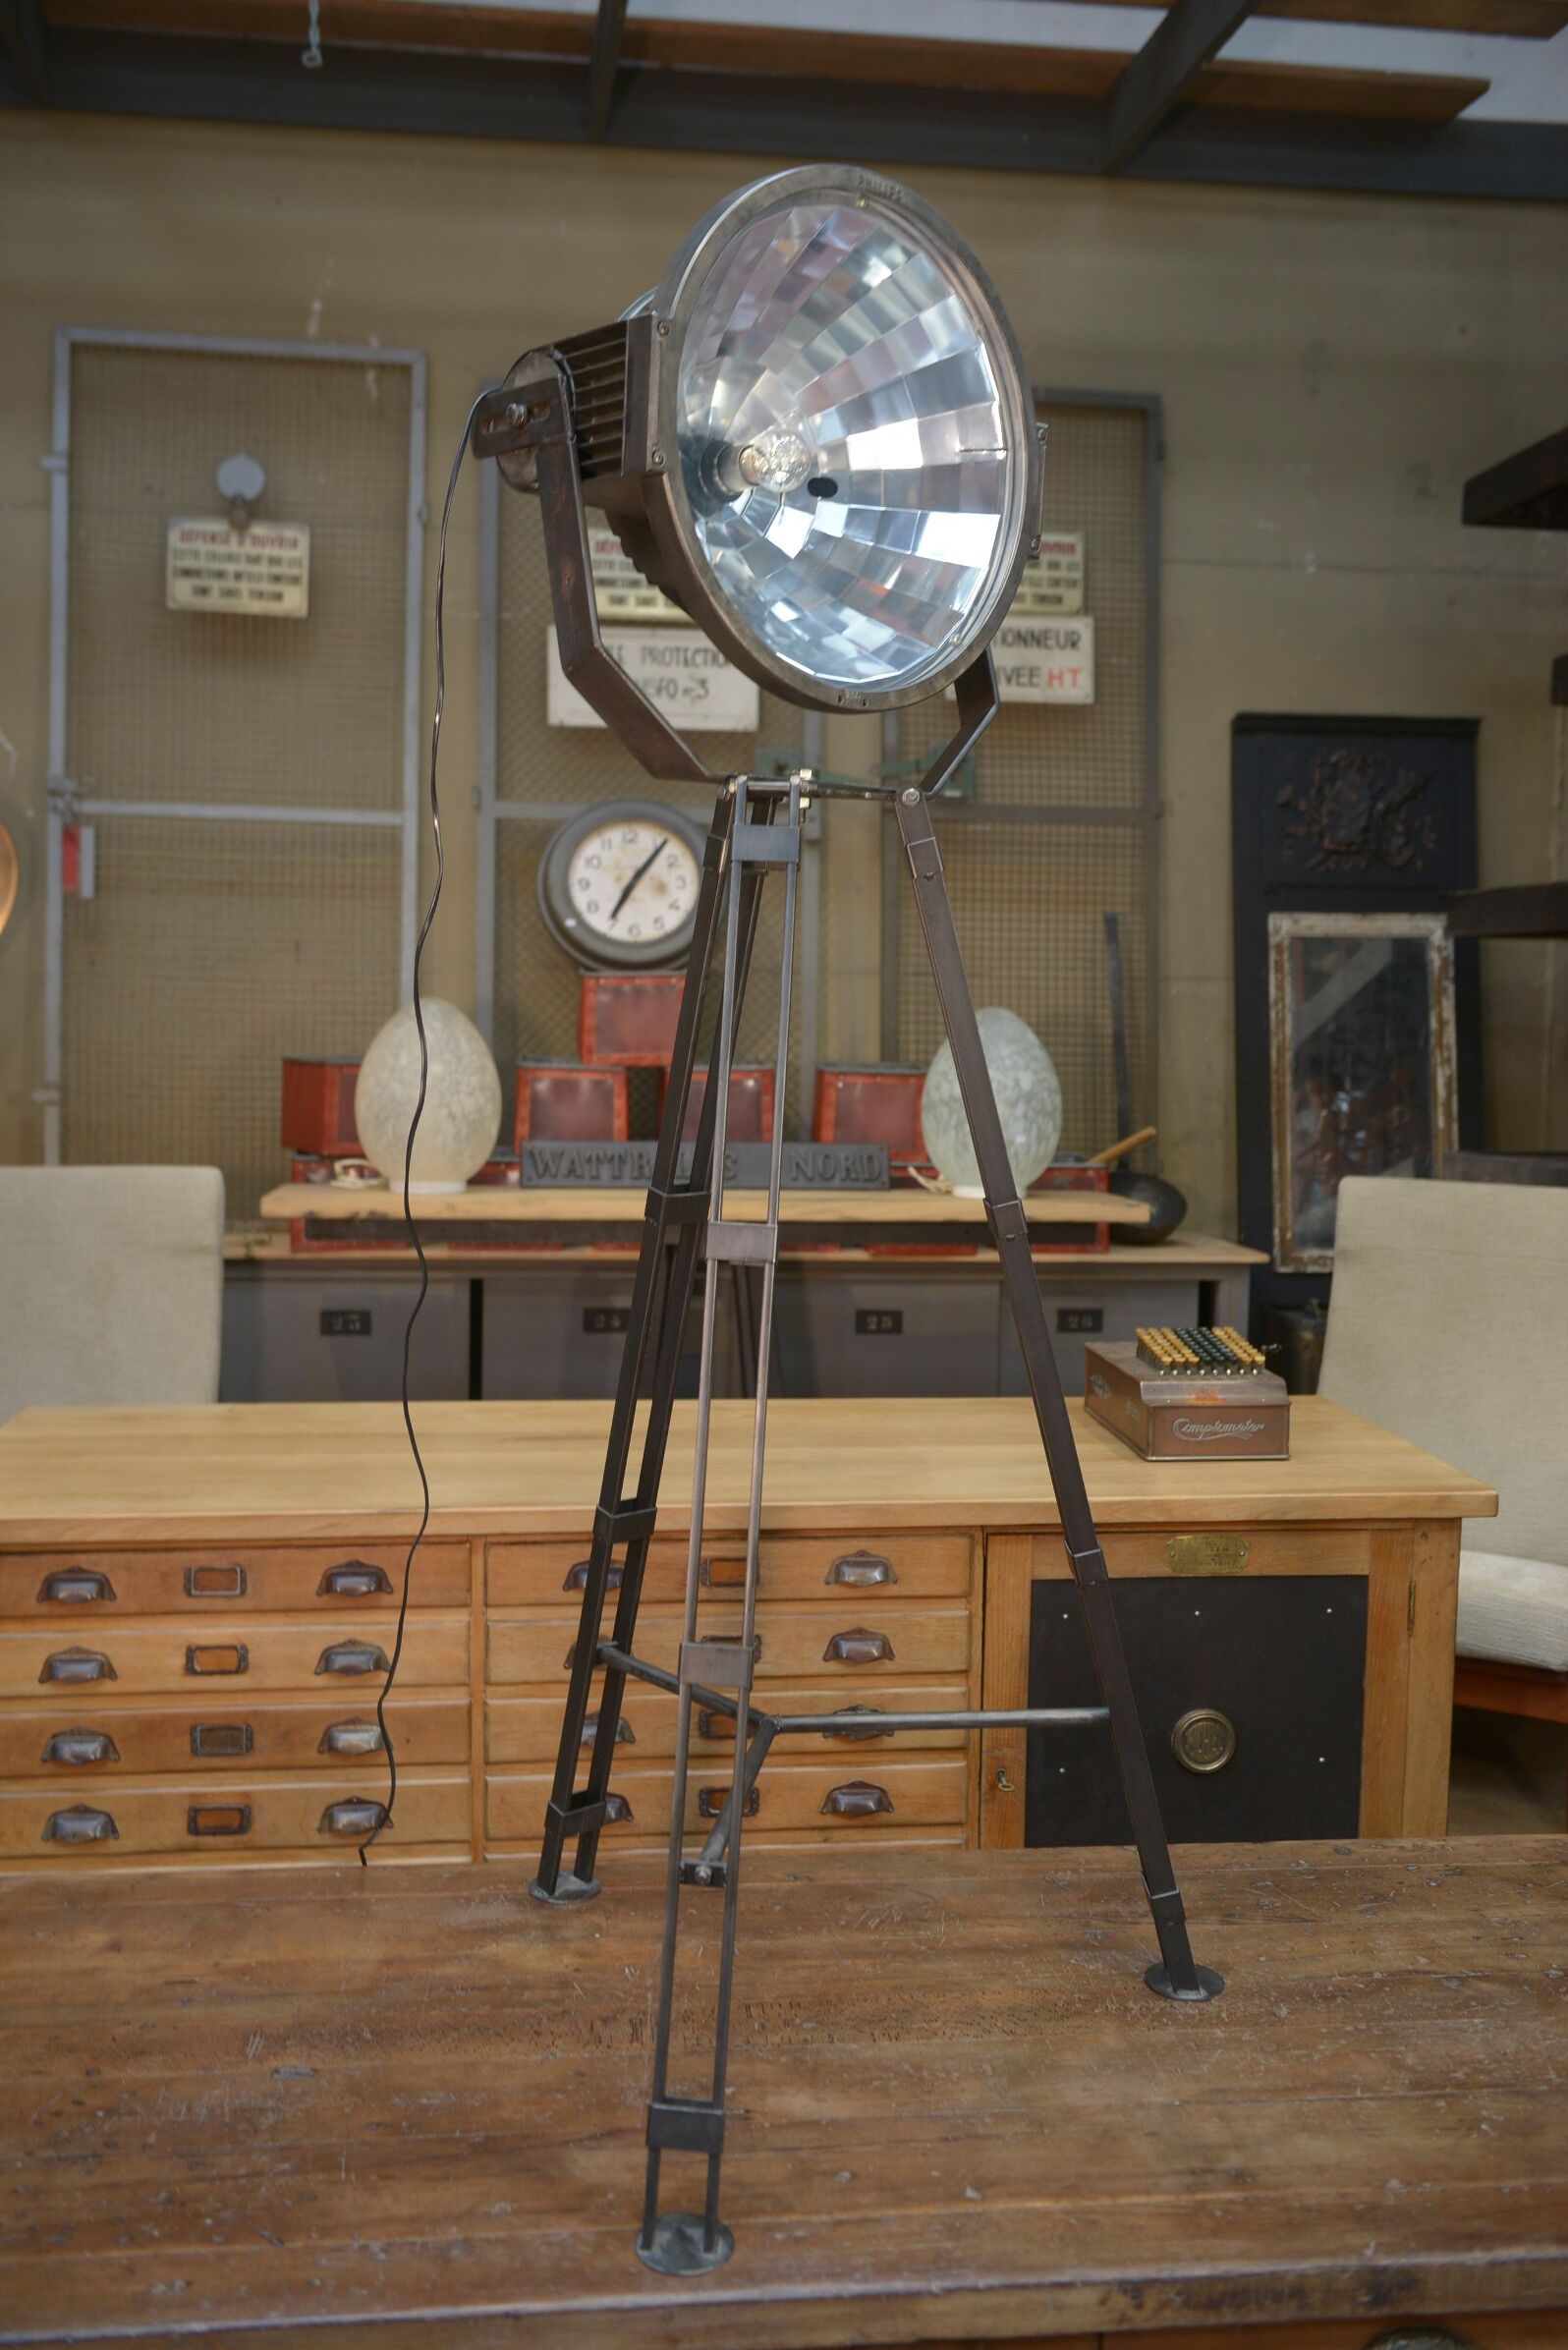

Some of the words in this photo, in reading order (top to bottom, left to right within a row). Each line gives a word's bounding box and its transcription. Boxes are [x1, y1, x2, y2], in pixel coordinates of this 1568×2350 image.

[641, 644, 729, 669] PROTECTIO
[1046, 666, 1084, 690] HT
[790, 1149, 882, 1182] NORD
